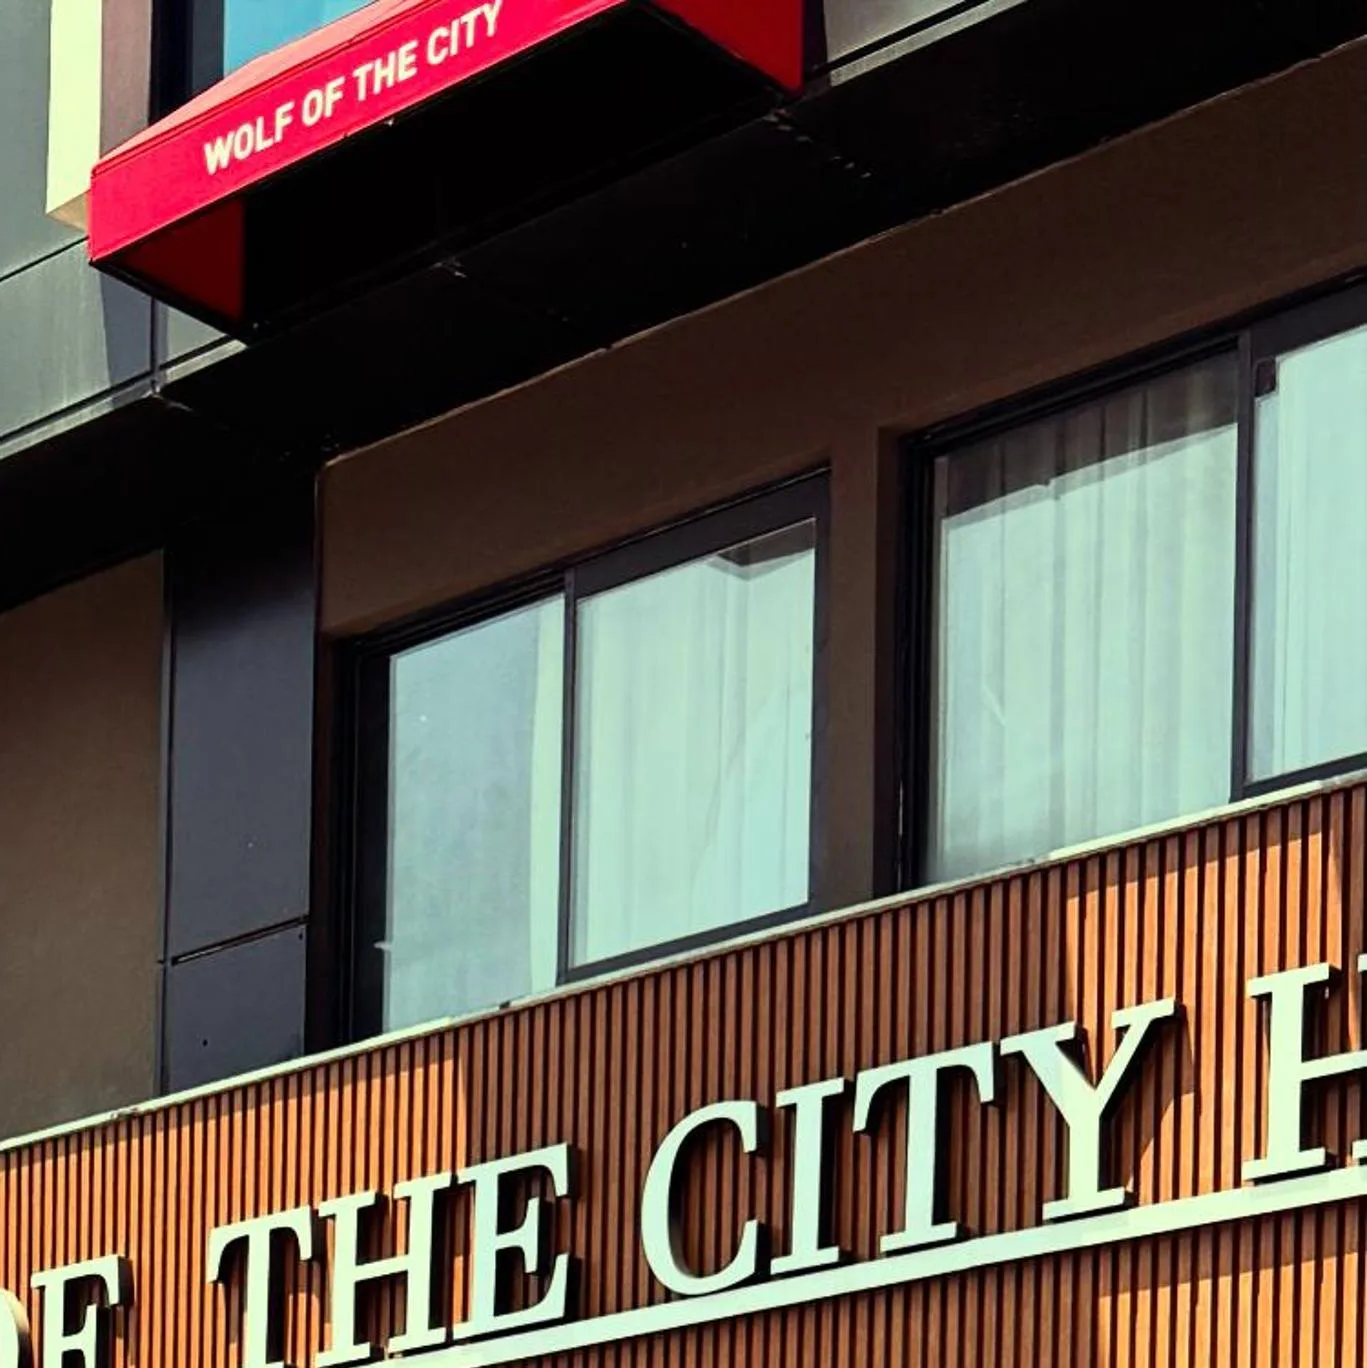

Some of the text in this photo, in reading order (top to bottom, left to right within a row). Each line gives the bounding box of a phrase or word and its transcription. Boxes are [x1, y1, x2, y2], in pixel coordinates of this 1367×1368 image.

[204, 0, 503, 175] WOLF OF THE CITY
[640, 997, 1176, 1297] CITY
